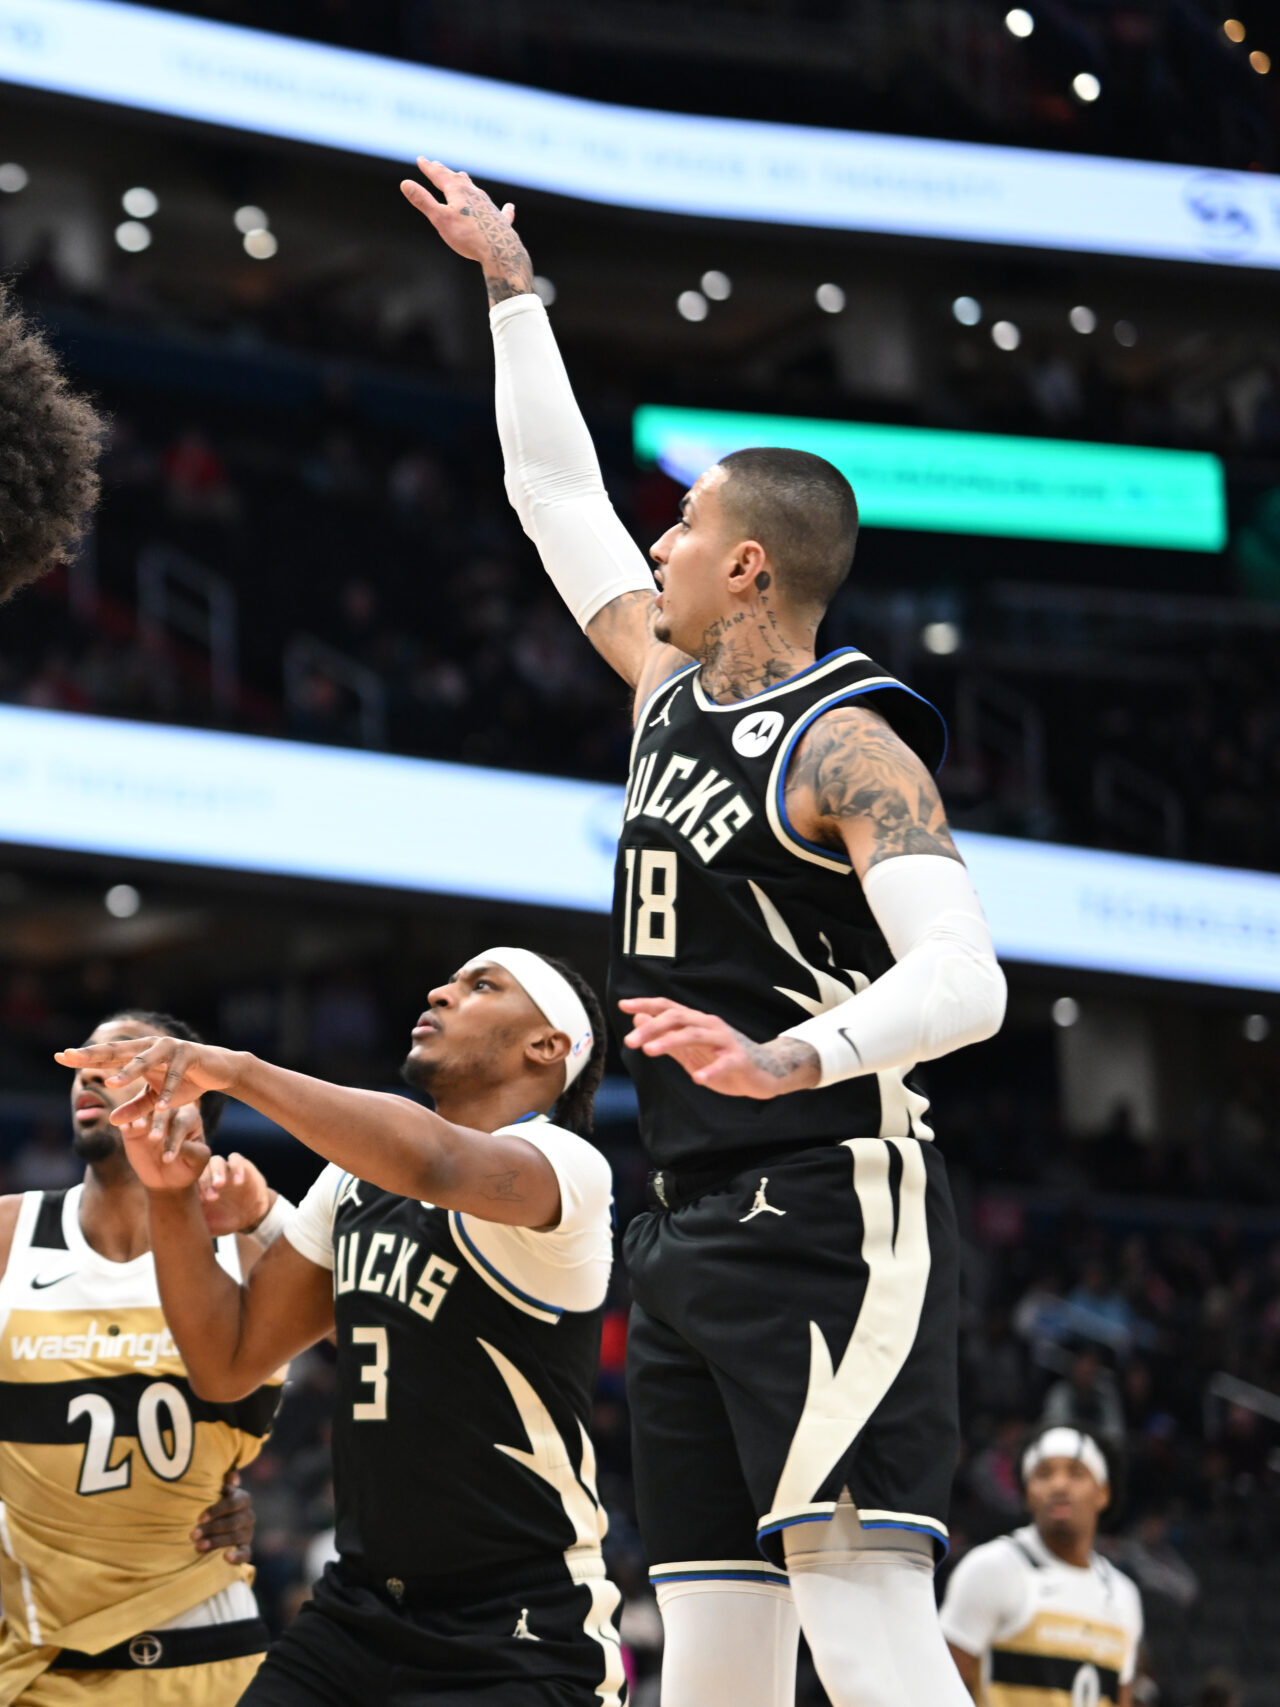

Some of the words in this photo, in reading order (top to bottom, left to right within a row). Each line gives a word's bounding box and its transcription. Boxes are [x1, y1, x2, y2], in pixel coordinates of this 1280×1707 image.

[625, 751, 754, 865] UCKS
[622, 847, 677, 959] 18
[337, 1231, 460, 1323] UCKS
[11, 1320, 181, 1367] washingt
[352, 1326, 389, 1421] 3
[67, 1381, 195, 1497] 20
